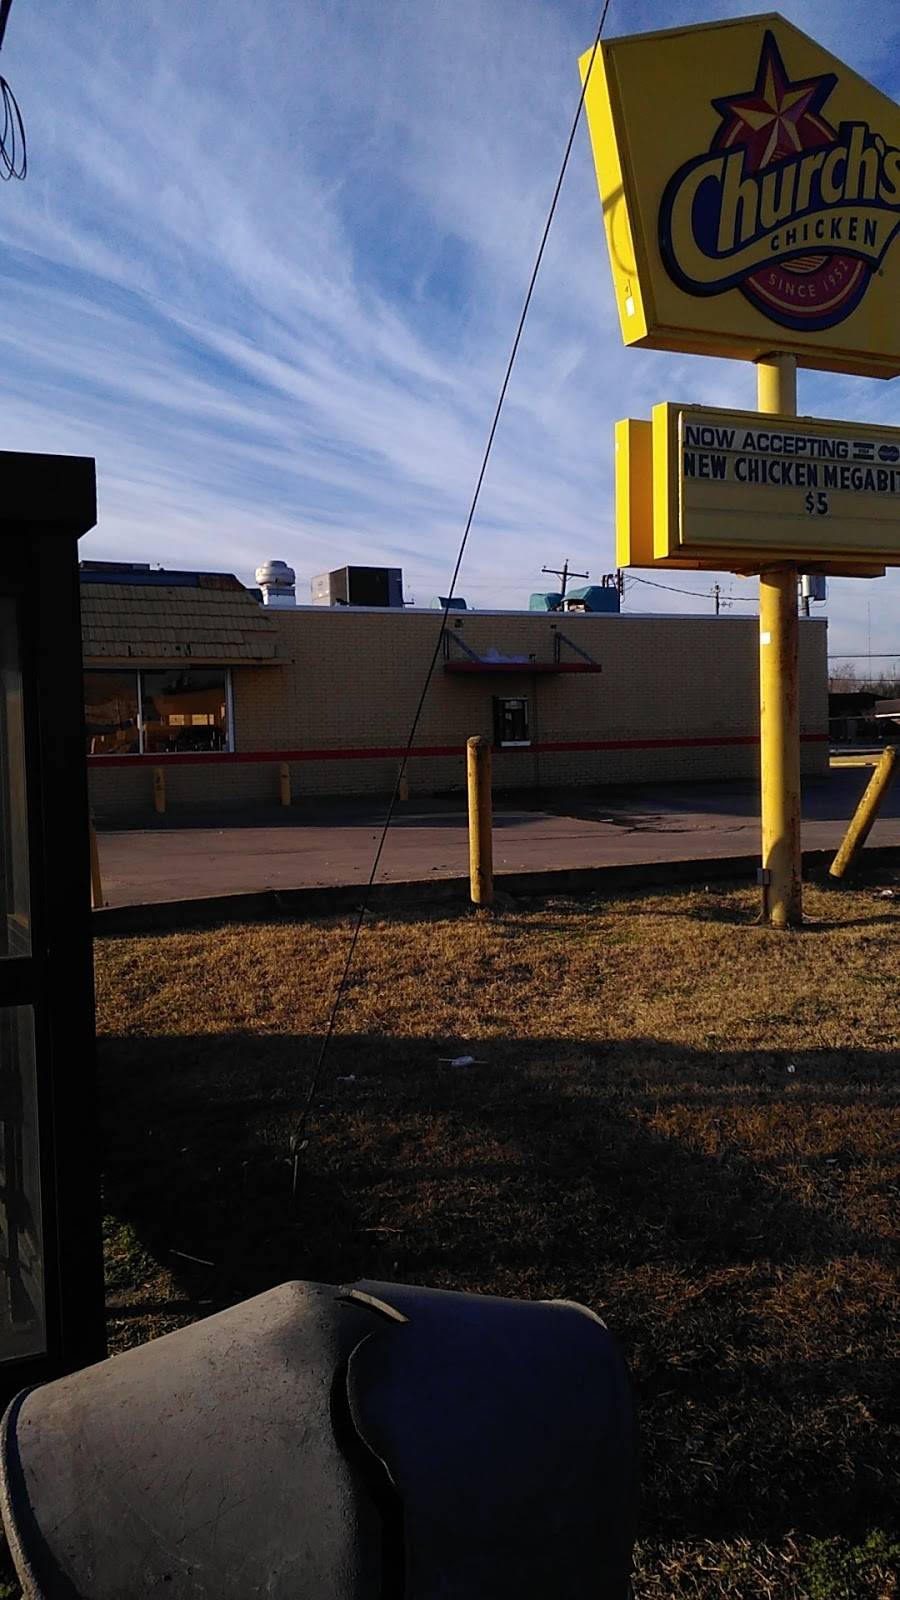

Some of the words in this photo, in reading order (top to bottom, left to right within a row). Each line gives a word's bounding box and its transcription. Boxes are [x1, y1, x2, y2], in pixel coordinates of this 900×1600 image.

[770, 216, 878, 251] CHICKEN
[768, 273, 817, 298] SINCE
[823, 259, 850, 292] 1952
[685, 426, 736, 448] NOW
[742, 432, 849, 459] ACCEPTING
[684, 453, 727, 479] NEW
[734, 457, 818, 487] CHICKEN
[805, 491, 828, 515] $5
